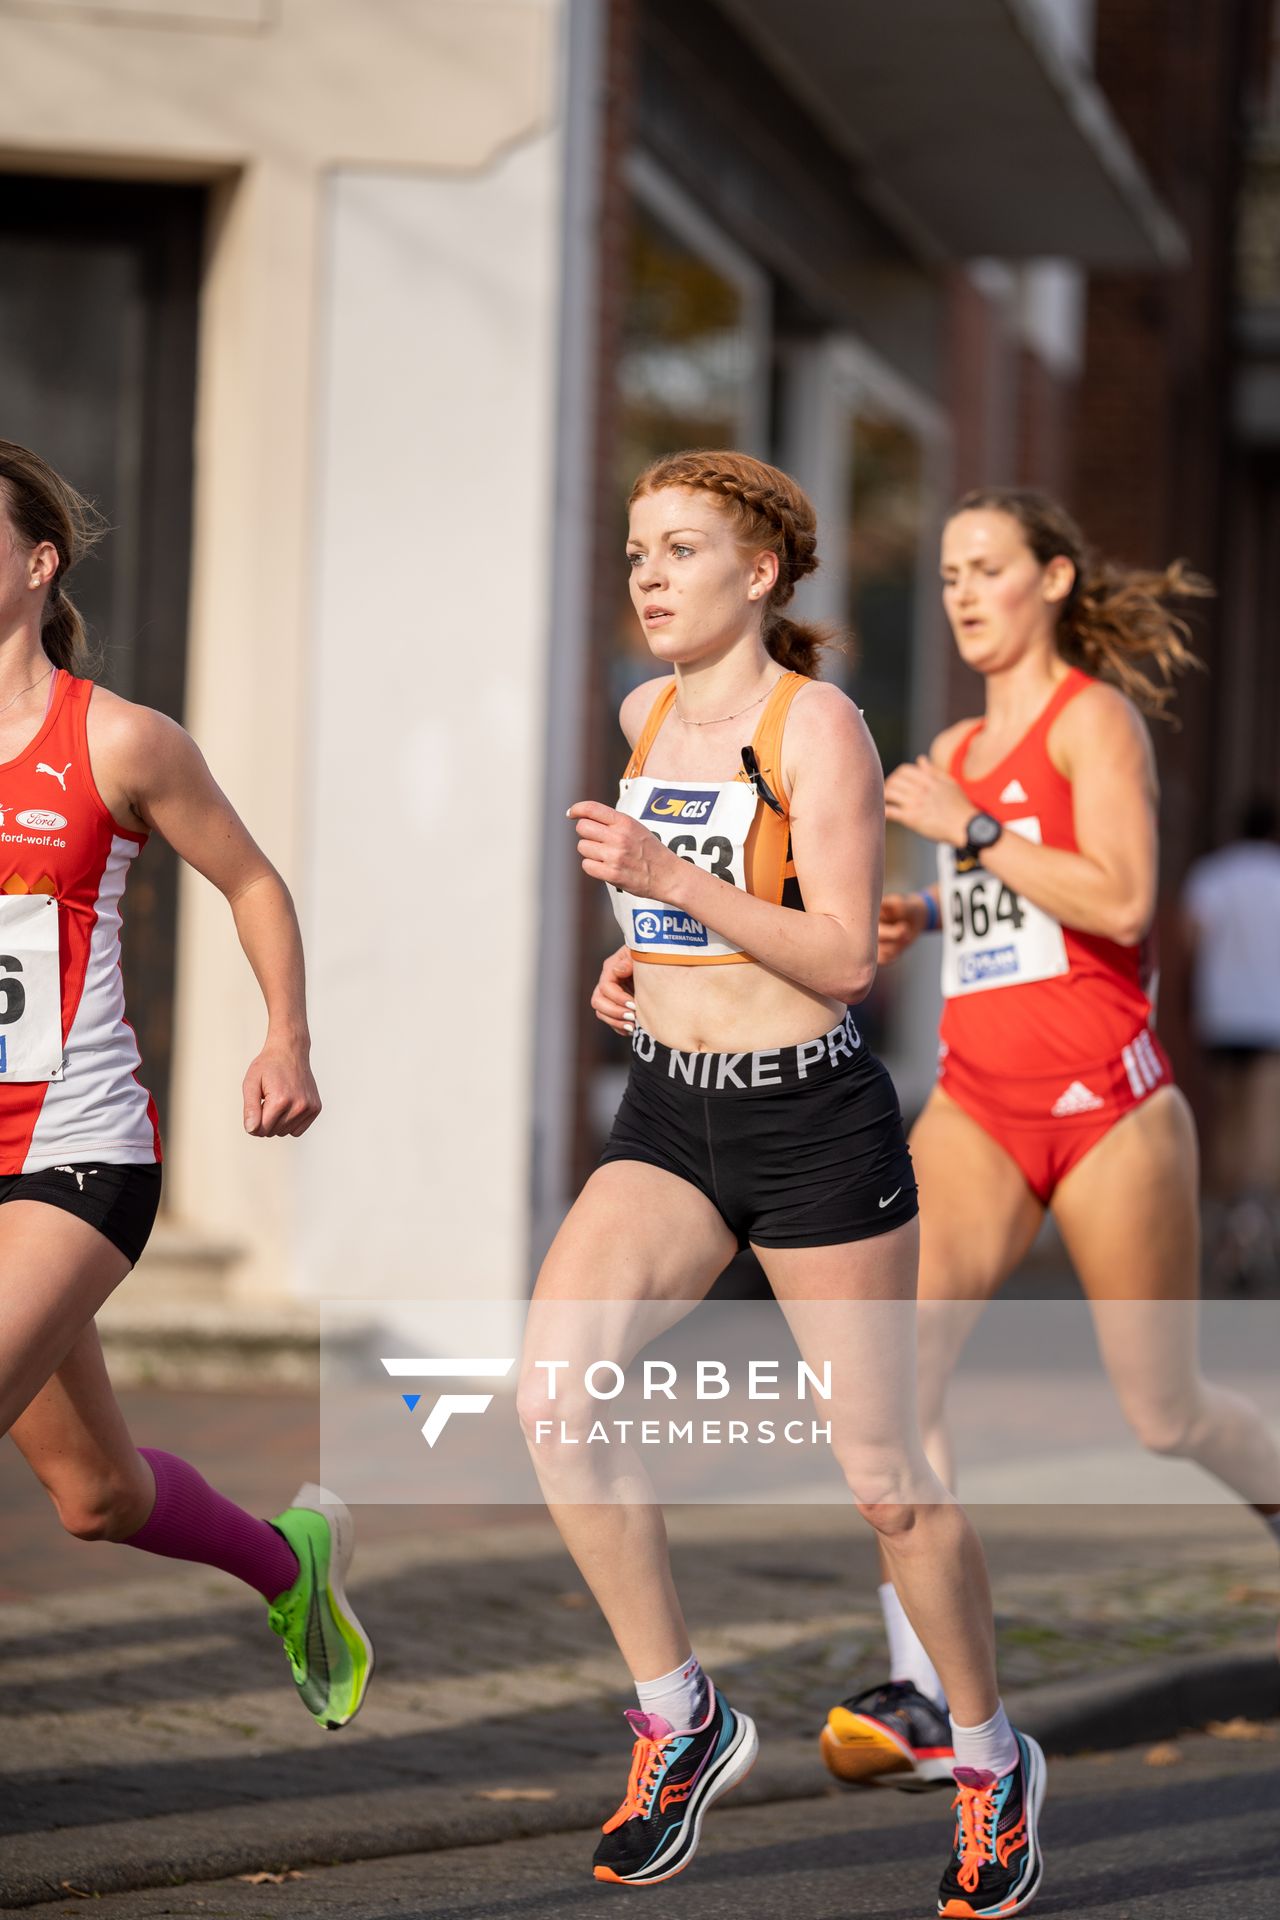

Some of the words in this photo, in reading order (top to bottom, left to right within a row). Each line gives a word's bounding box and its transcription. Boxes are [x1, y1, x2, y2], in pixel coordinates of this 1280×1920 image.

[681, 800, 711, 818] GLS
[26, 813, 57, 826] Ford
[1, 832, 66, 848] ford-wolf.de
[663, 915, 704, 934] PLAN
[668, 1047, 782, 1090] NIKE
[797, 1010, 861, 1079] PRO
